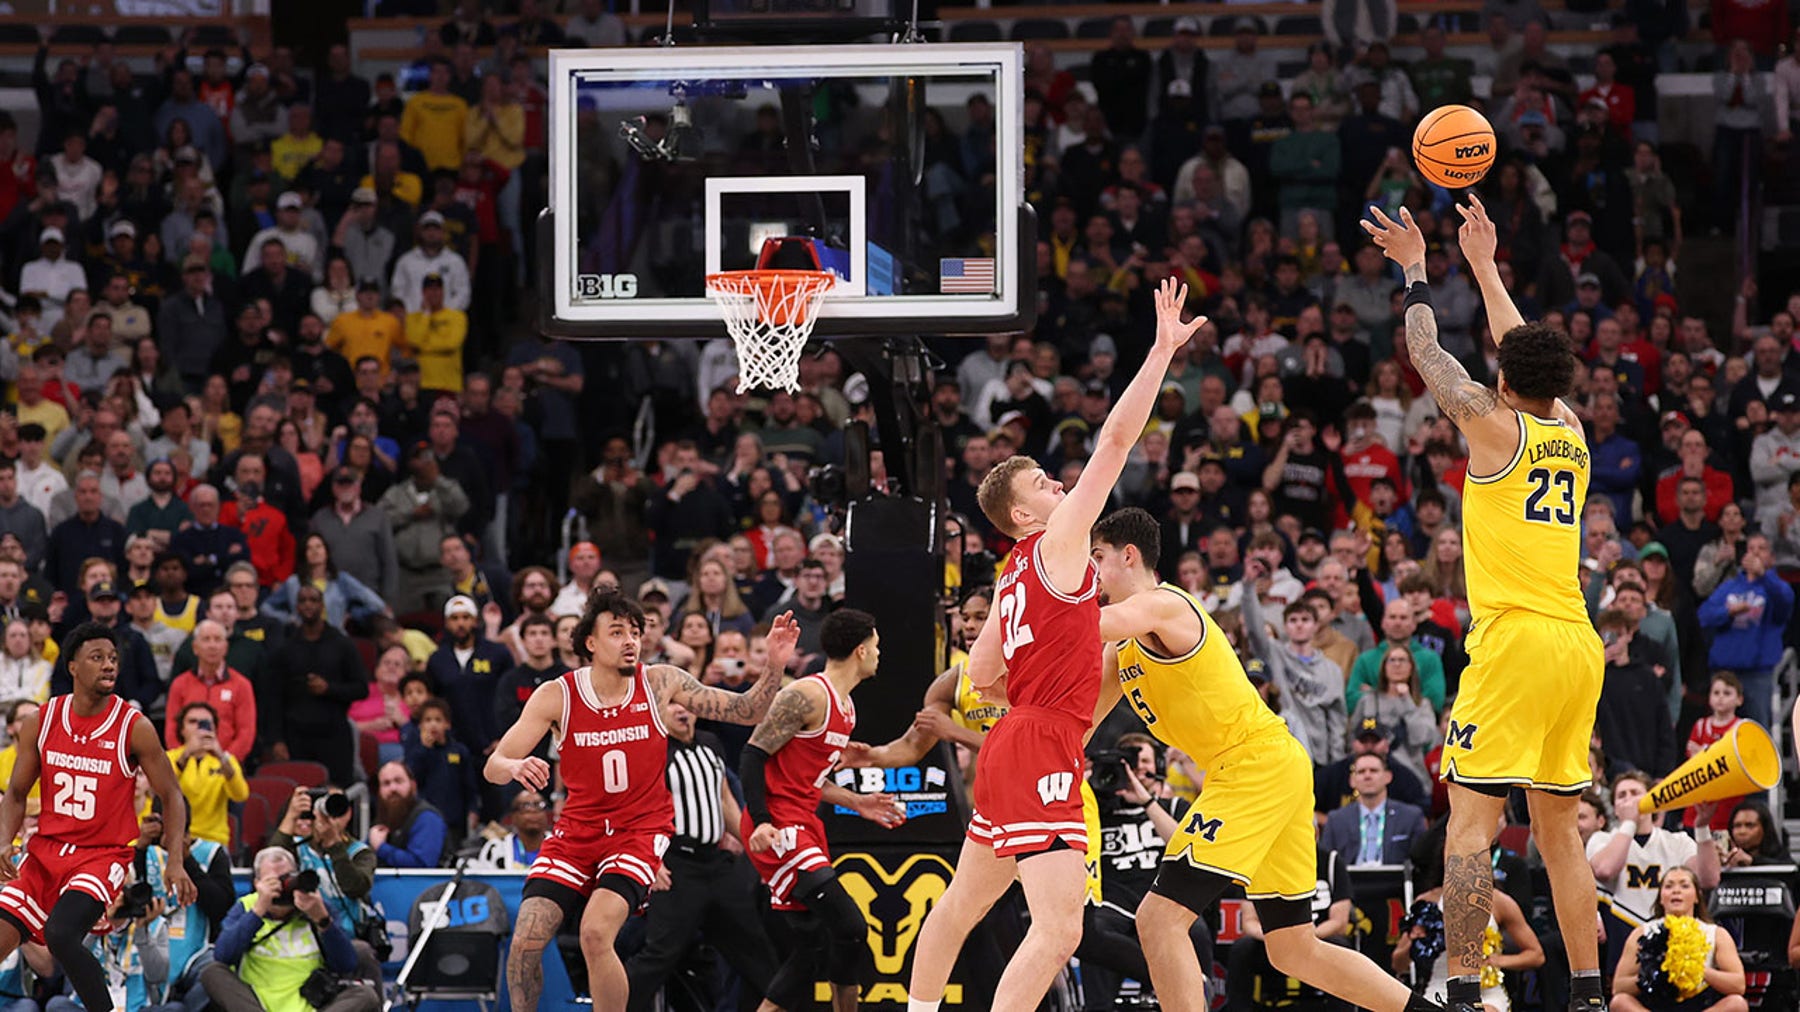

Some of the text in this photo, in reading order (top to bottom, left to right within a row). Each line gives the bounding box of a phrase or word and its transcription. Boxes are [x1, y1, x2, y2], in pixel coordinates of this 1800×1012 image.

[1455, 143, 1489, 158] NCAA
[1525, 467, 1576, 525] 23
[1000, 582, 1035, 660] 32
[1131, 688, 1157, 724] 5
[573, 724, 650, 747] WISCONSIN
[1446, 720, 1478, 750] M
[46, 750, 112, 775] WISCONSIN
[602, 749, 629, 793] 0
[54, 772, 97, 820] 25
[1037, 771, 1074, 807] W
[1651, 755, 1730, 809] MICHIGAN
[1184, 813, 1223, 842] M
[1111, 850, 1160, 871] TV
[1627, 864, 1661, 889] M
[1717, 887, 1764, 896] UNITED
[1719, 897, 1763, 905] CENTER
